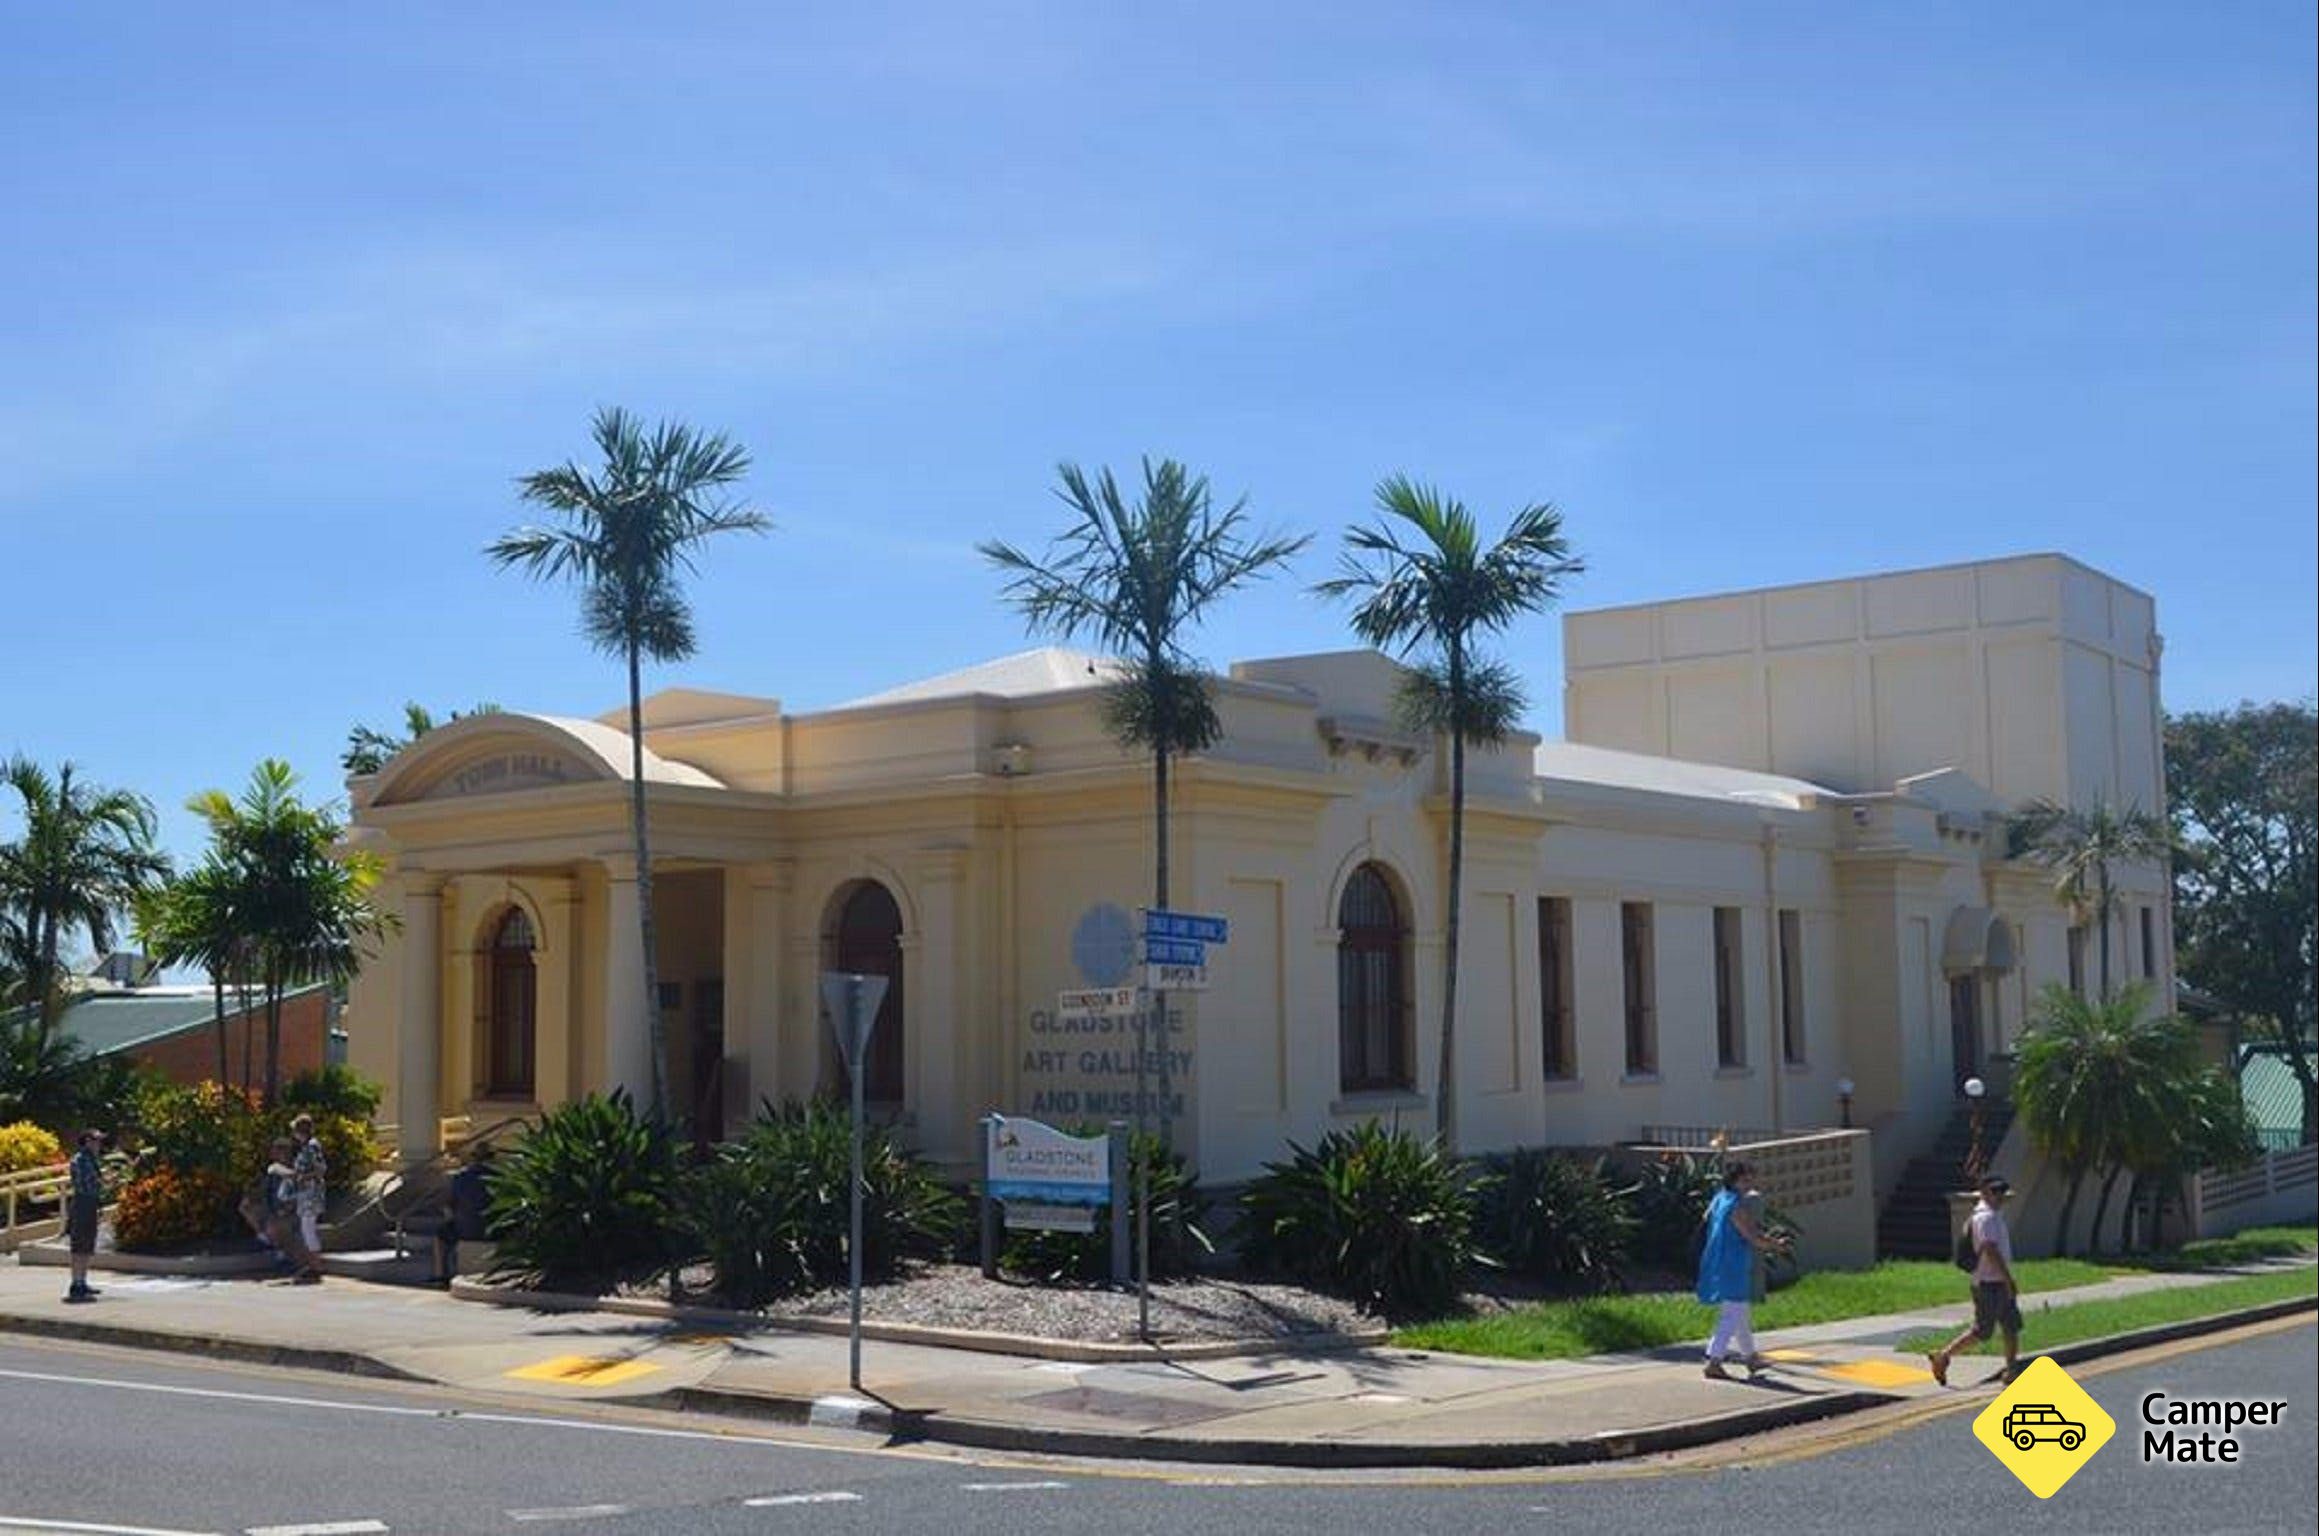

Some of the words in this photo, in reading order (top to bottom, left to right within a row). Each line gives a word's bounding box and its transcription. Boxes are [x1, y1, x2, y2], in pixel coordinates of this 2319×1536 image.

[1023, 1050, 1067, 1073] ART
[1079, 1050, 1193, 1075] GALLERY
[1032, 1090, 1080, 1113] AND
